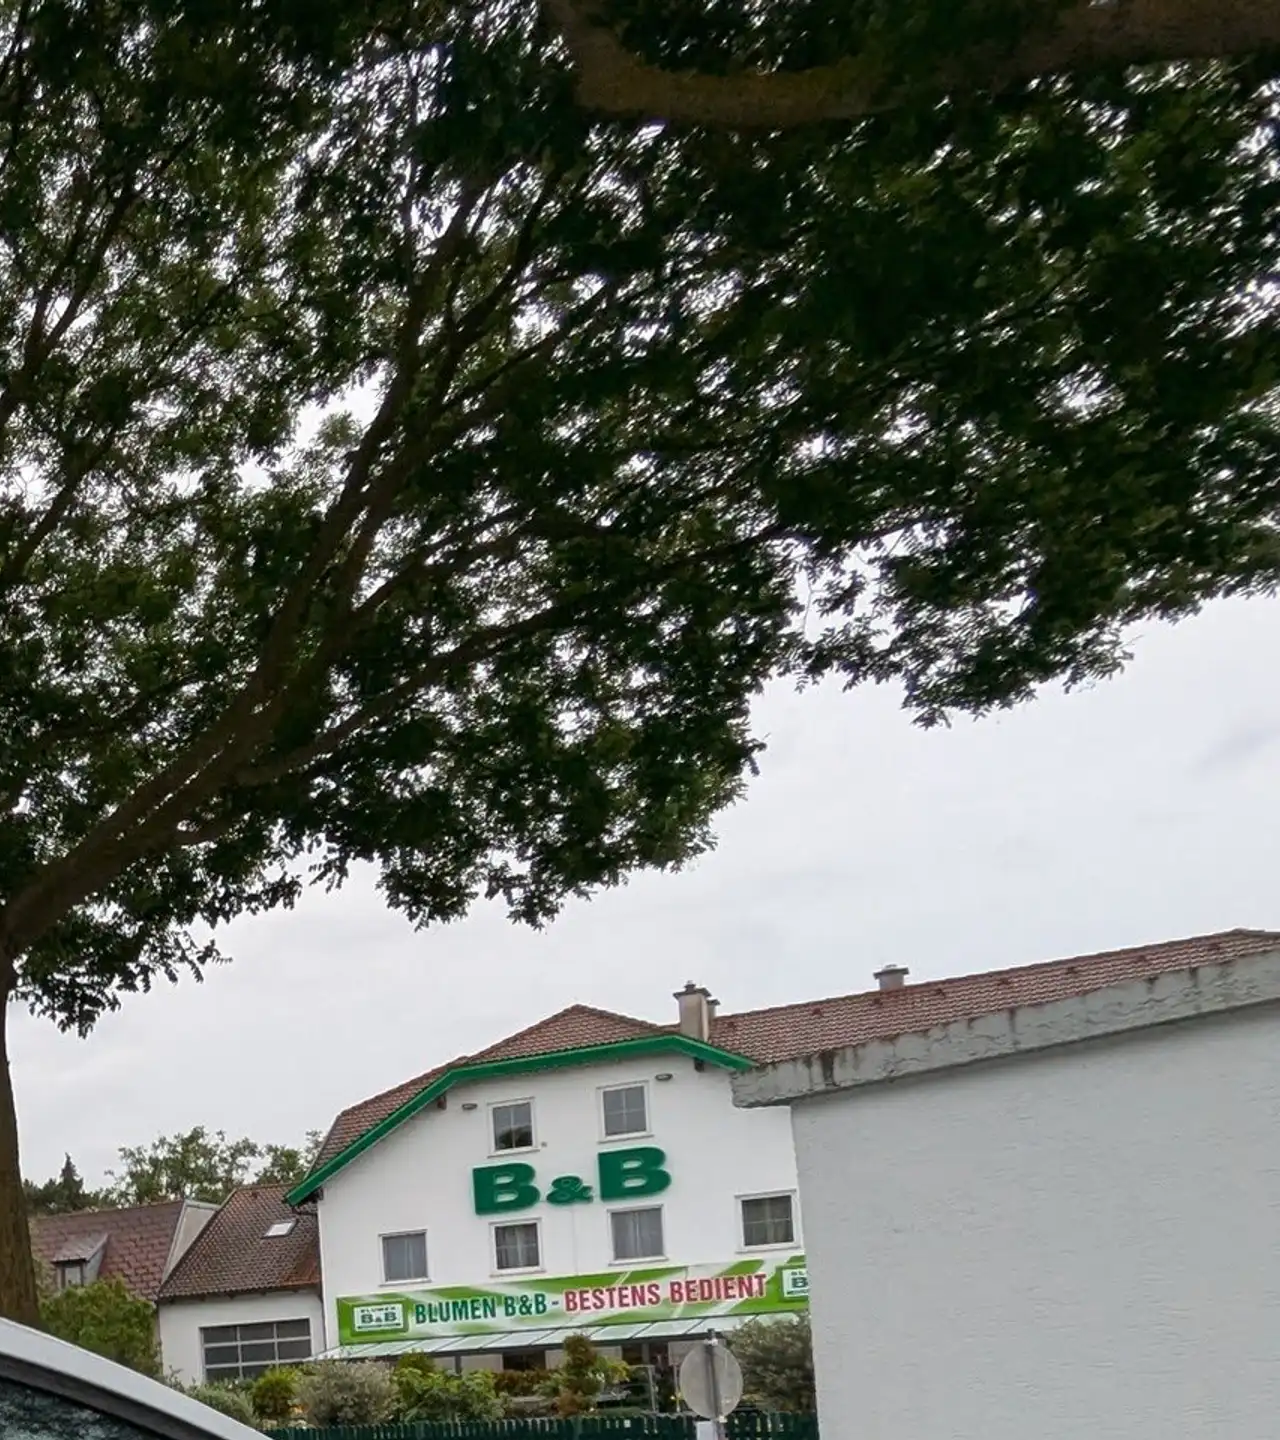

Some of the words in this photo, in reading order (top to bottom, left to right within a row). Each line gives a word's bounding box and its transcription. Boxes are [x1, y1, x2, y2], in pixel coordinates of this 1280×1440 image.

[471, 1145, 672, 1216] B&B
[414, 1301, 496, 1325] BLUMEN
[504, 1293, 547, 1317] B&B
[564, 1284, 661, 1312] BESTENS
[670, 1273, 767, 1302] BEDIENT
